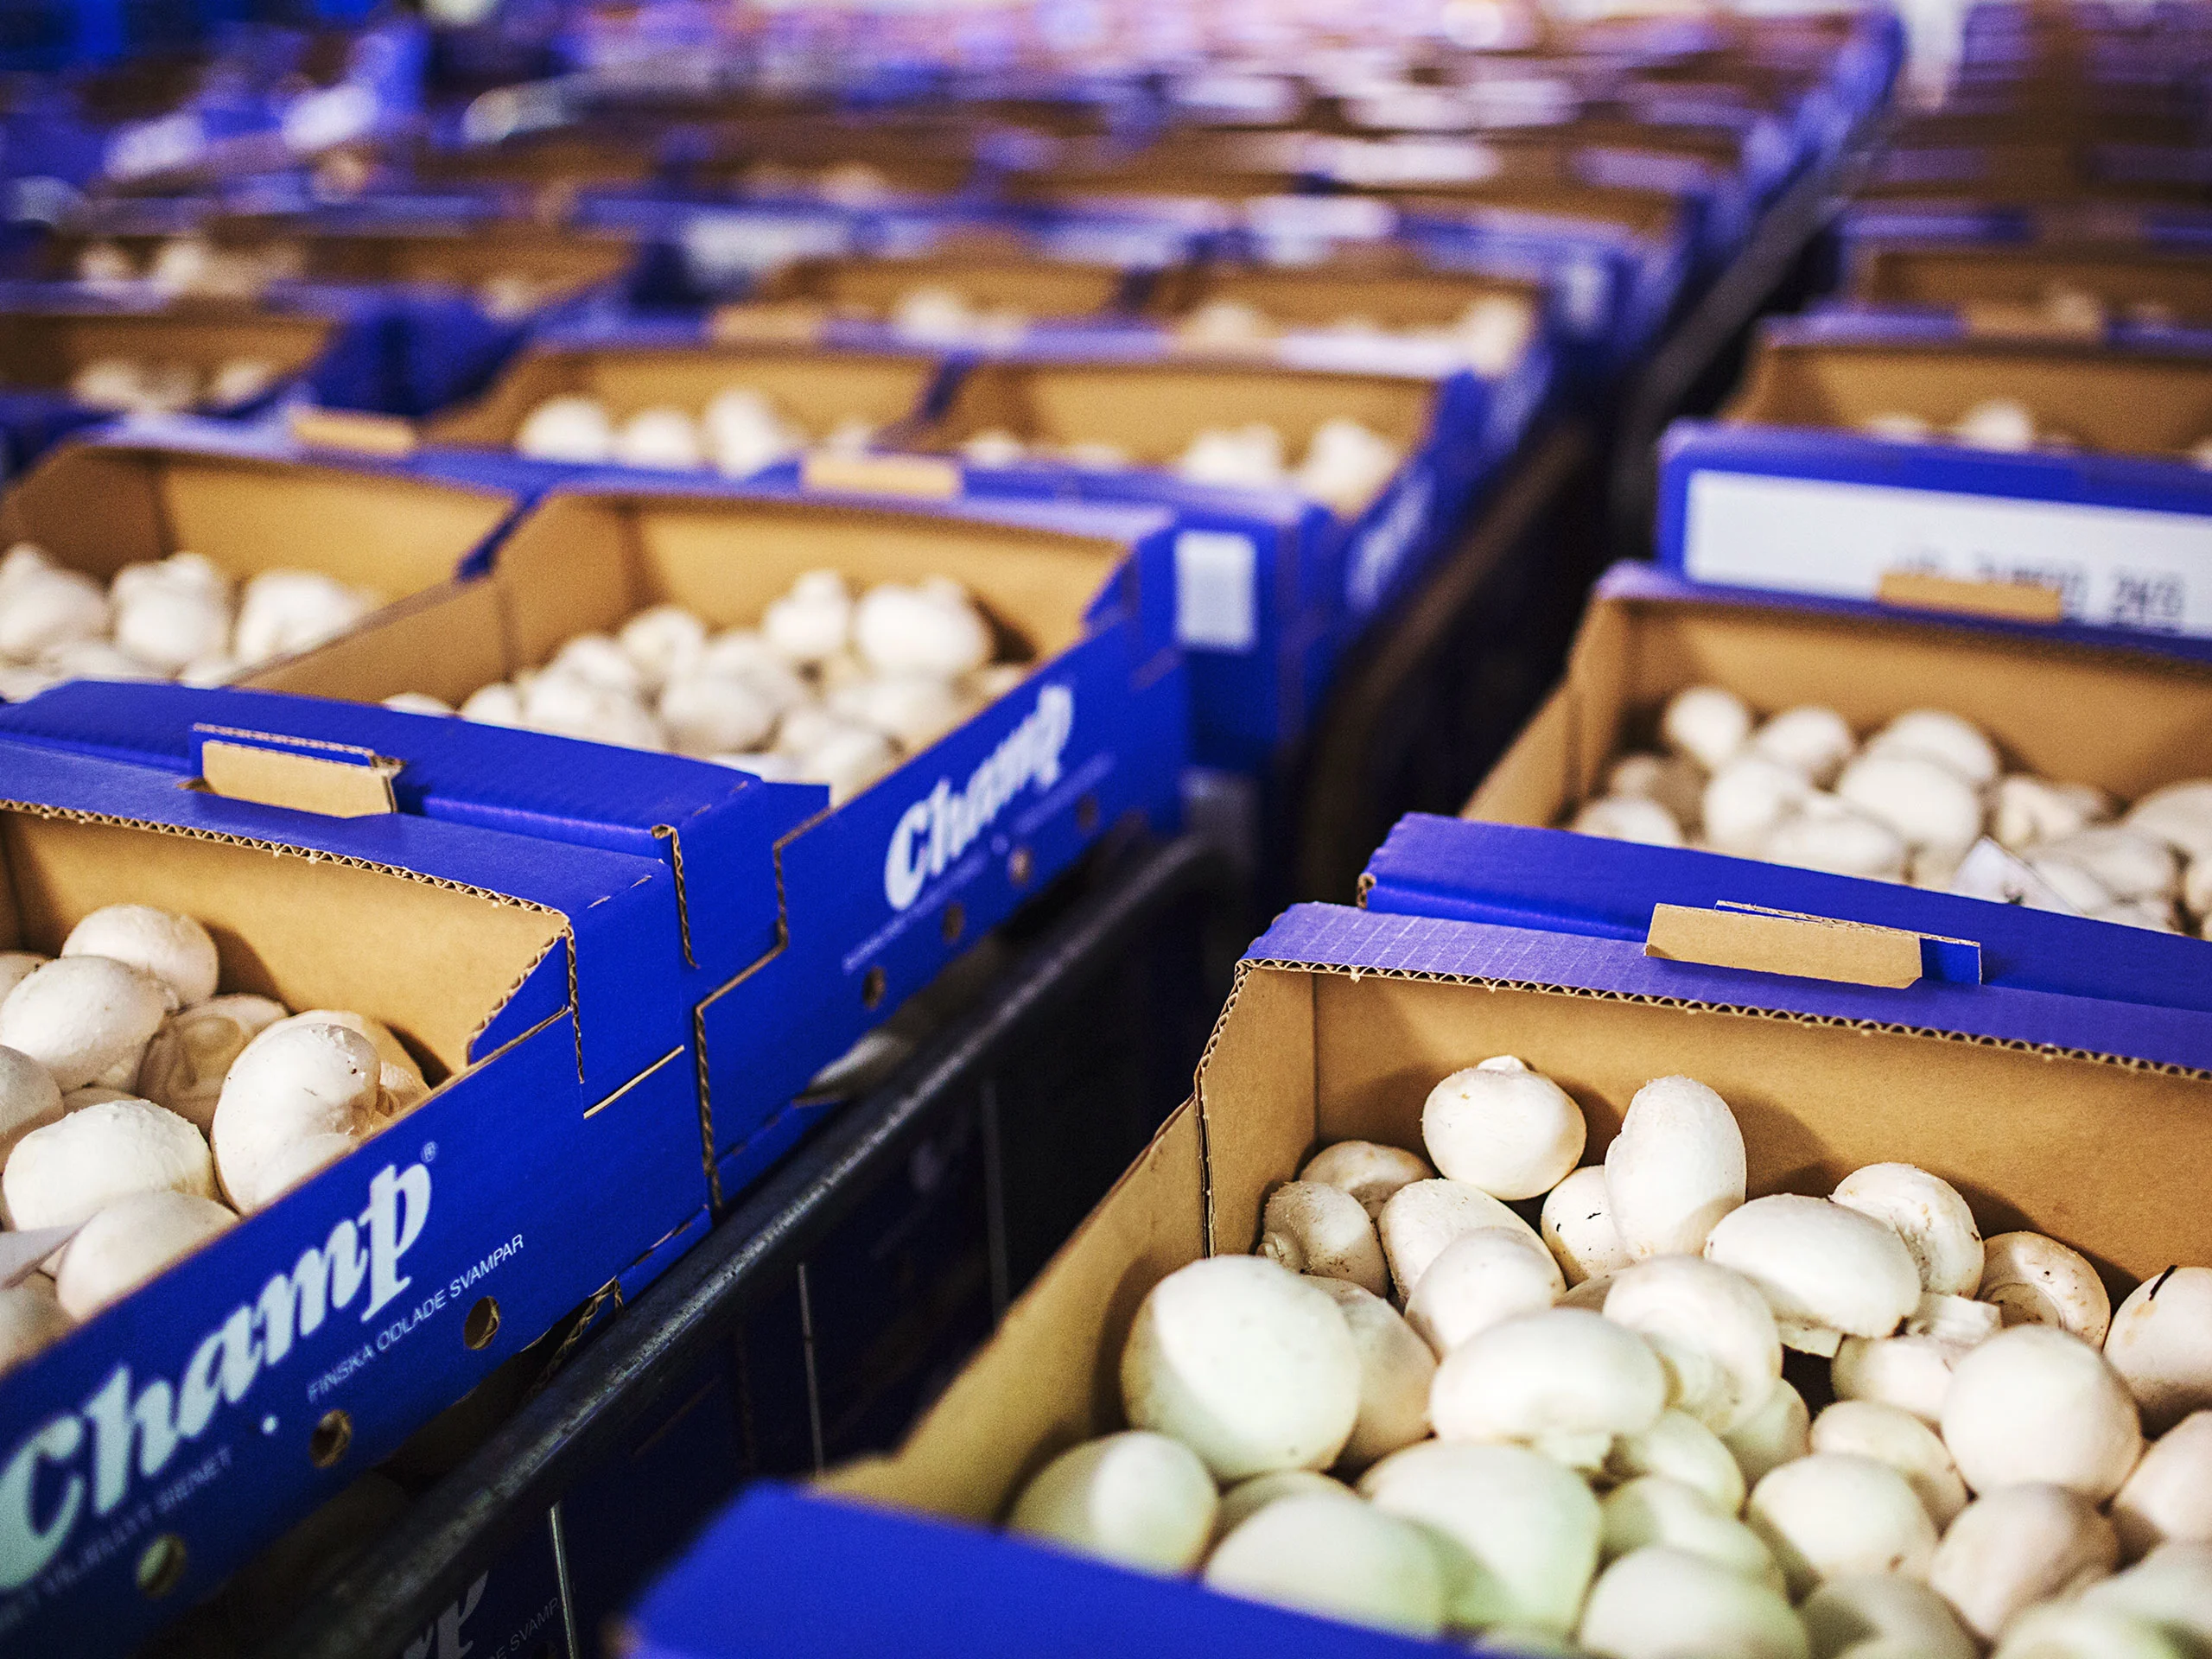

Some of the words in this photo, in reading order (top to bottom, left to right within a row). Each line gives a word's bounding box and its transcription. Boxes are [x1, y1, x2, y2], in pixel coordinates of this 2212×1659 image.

[307, 1343, 376, 1404] FINSKA
[377, 1288, 447, 1353] ODLADE
[449, 1233, 525, 1299] SVAMPAR
[510, 1595, 563, 1652] SVAMP
